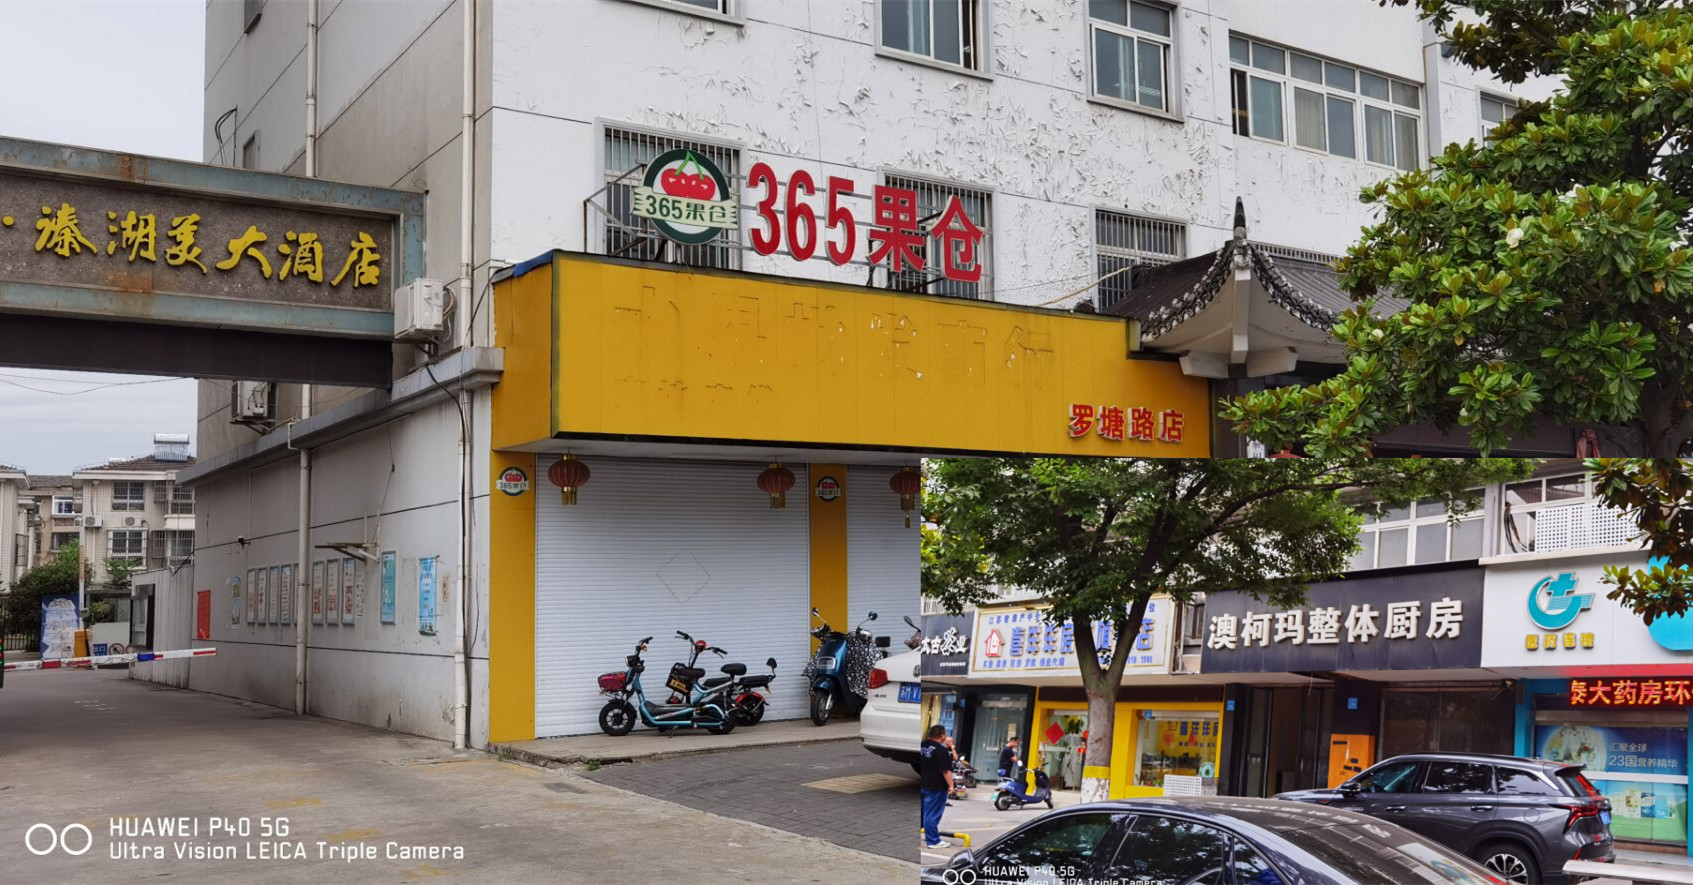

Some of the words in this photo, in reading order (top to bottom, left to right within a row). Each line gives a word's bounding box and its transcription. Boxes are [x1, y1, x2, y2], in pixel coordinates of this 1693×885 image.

[645, 194, 727, 223] 365果仓
[746, 162, 983, 283] 365果仓
[1068, 404, 1184, 442] 罗塘路店
[1207, 596, 1464, 650] 澳柯玛整体厨房
